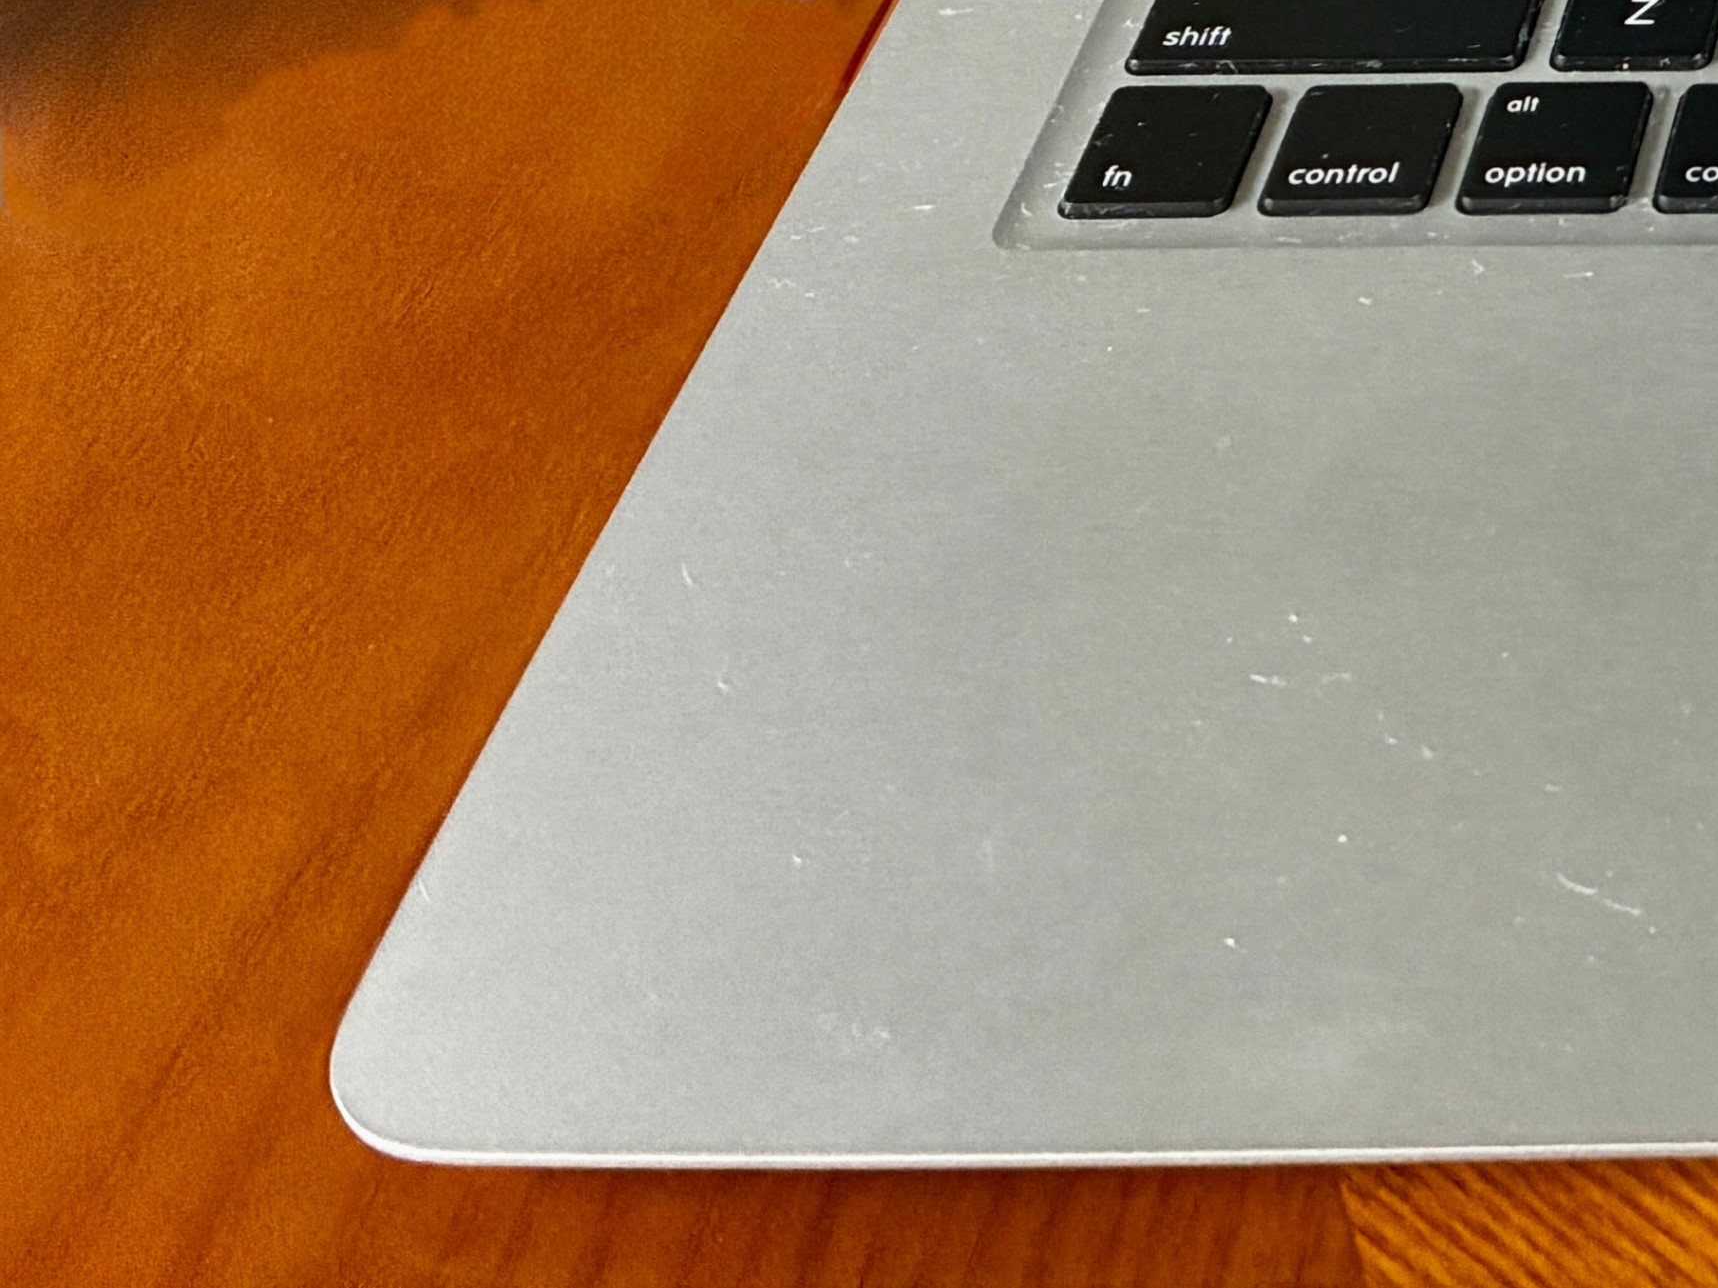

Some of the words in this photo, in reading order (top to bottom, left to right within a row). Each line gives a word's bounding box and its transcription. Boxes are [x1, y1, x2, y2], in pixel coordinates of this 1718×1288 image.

[1162, 25, 1232, 47] shift
[1506, 95, 1540, 113] alt
[1102, 164, 1133, 187] fn
[1288, 161, 1400, 185] control
[1484, 162, 1586, 188] option
